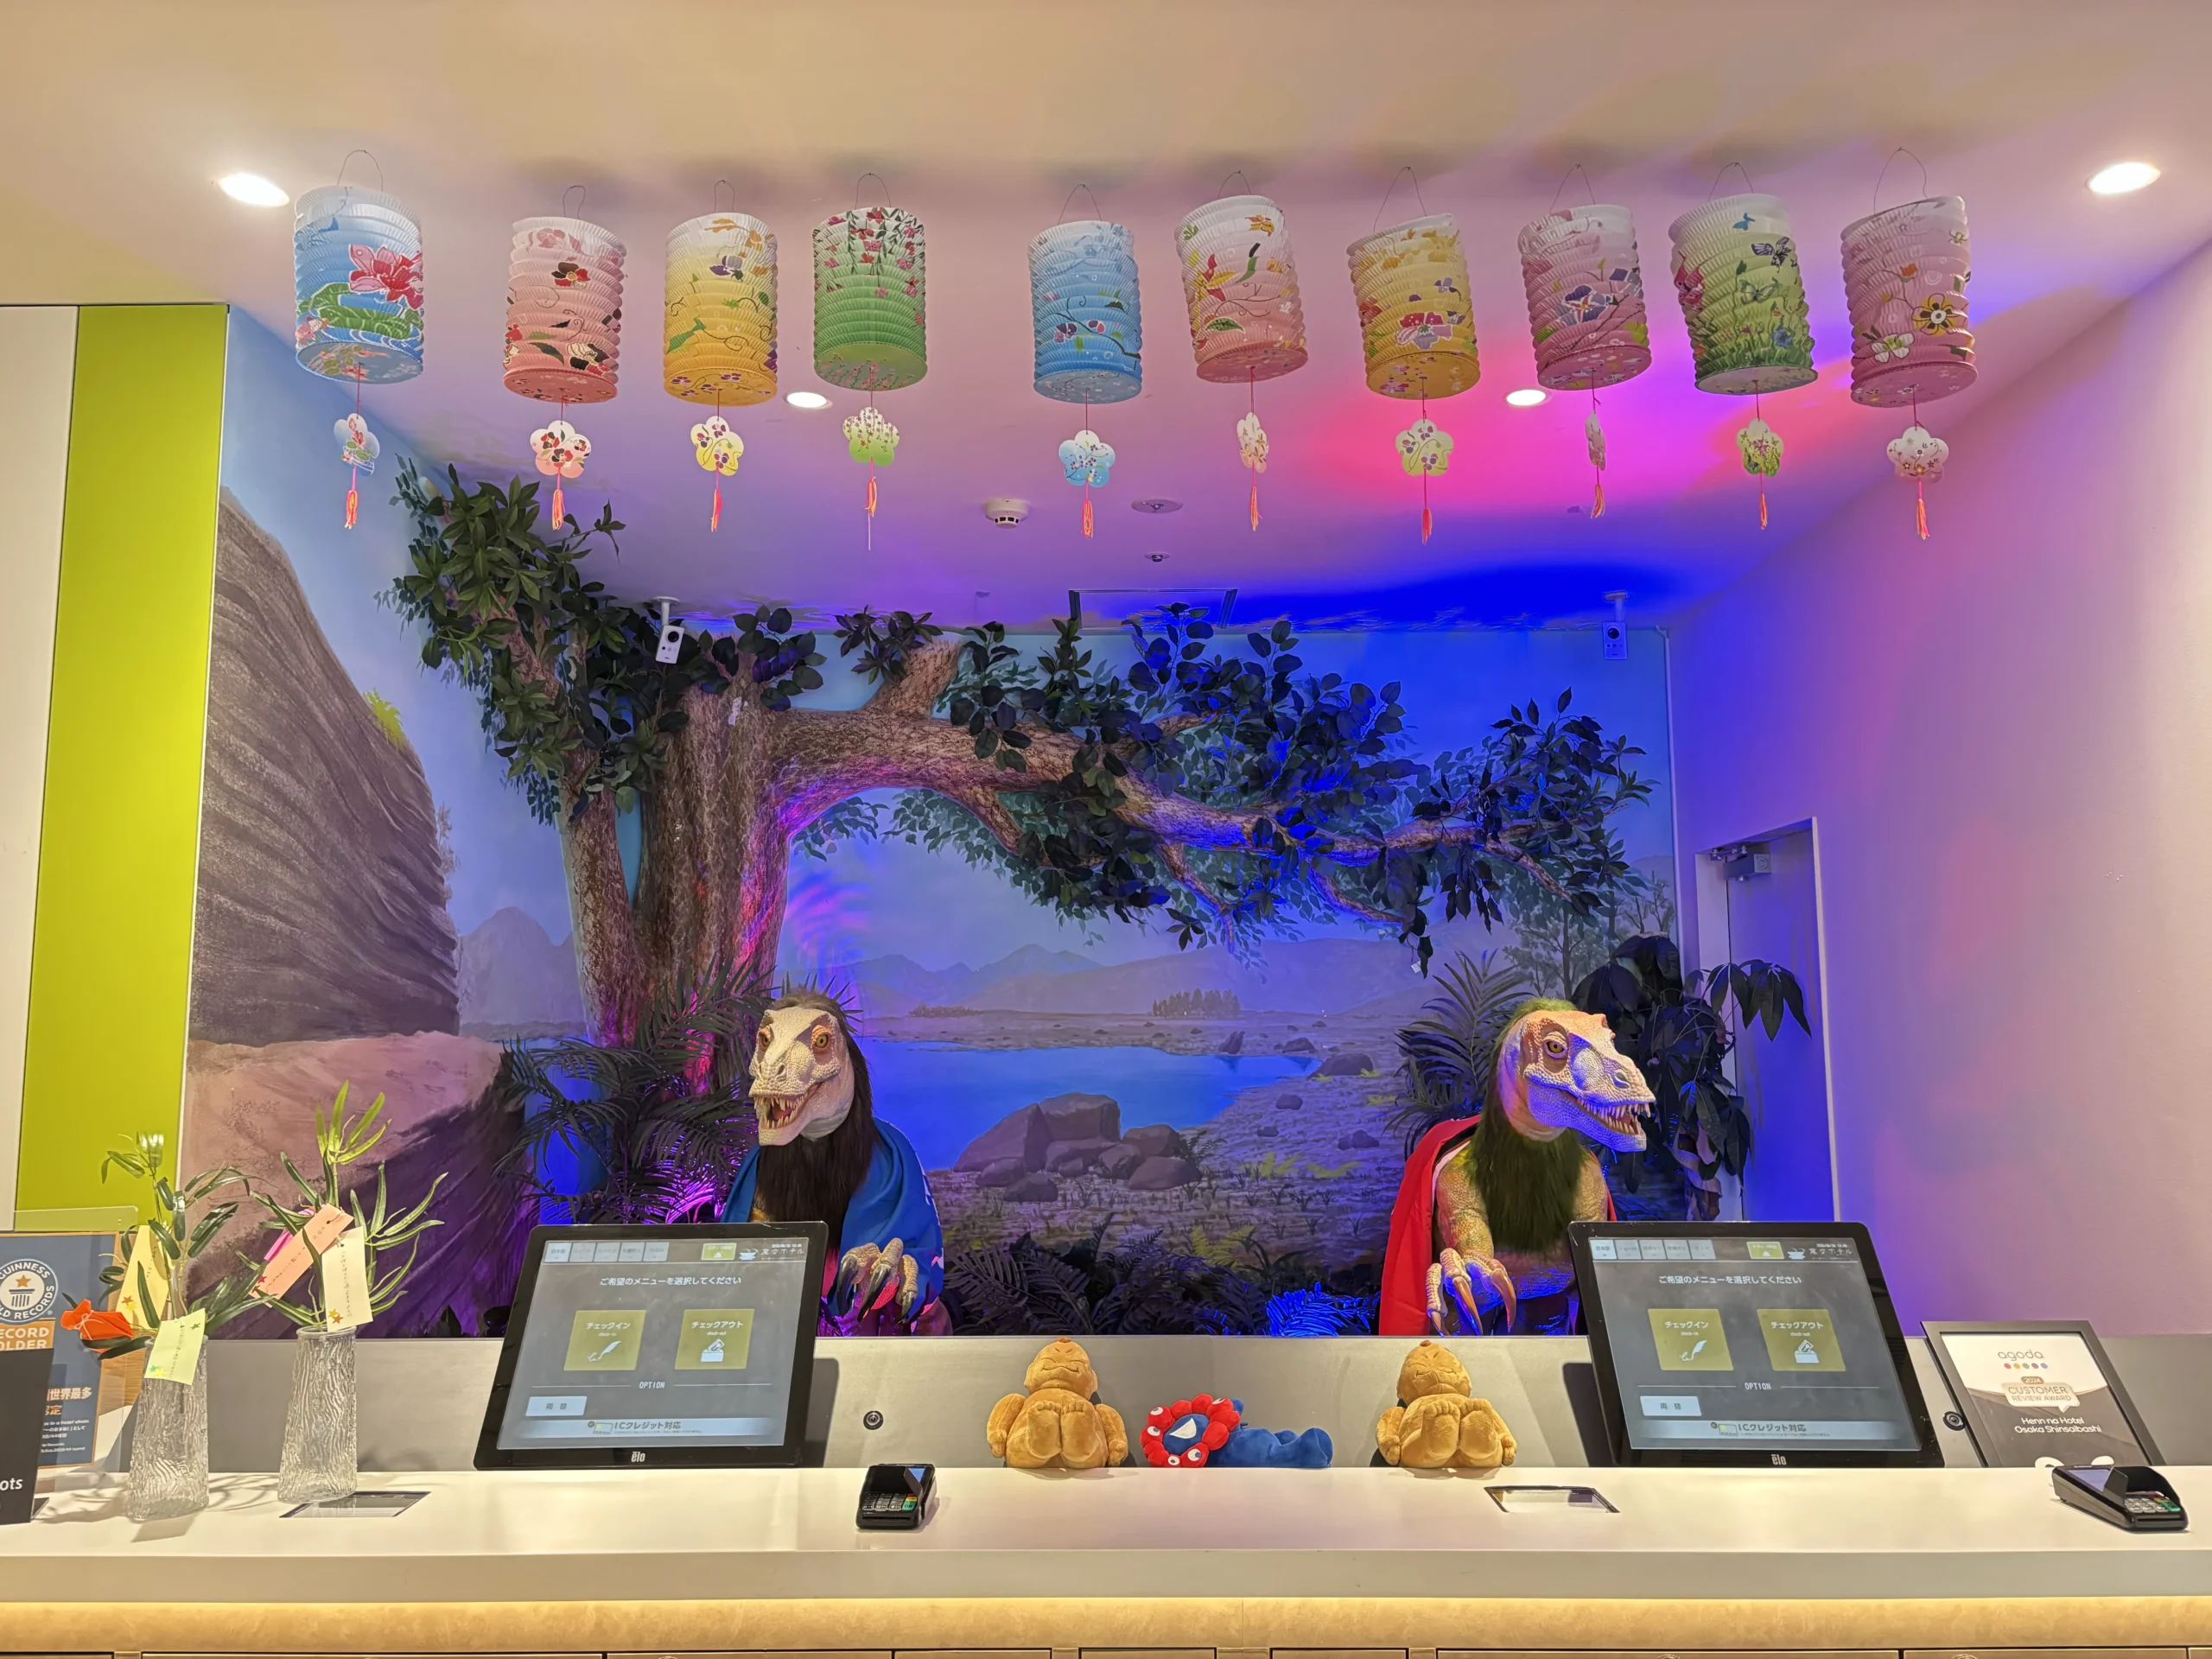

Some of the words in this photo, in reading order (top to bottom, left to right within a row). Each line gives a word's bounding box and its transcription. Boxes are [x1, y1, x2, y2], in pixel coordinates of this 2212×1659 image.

[0, 1262, 51, 1280] GUINNESS
[600, 1276, 741, 1286] ご希望のメニューを選択してください
[1658, 1275, 1802, 1285] ご希望のメニューを選択してください
[14, 1285, 54, 1319] RECORDS
[0, 1327, 49, 1338] ECORD
[0, 1339, 47, 1351] LDER
[1998, 1350, 2044, 1361] agoda
[47, 1387, 92, 1401] 世界最多
[2008, 1386, 2069, 1395] CUSTOMER
[614, 1421, 682, 1430] ICクレジット対応
[1738, 1423, 1807, 1432] ICクレジット対応
[2044, 1425, 2102, 1433] Shinsaibashi
[0, 1478, 23, 1491] ots
